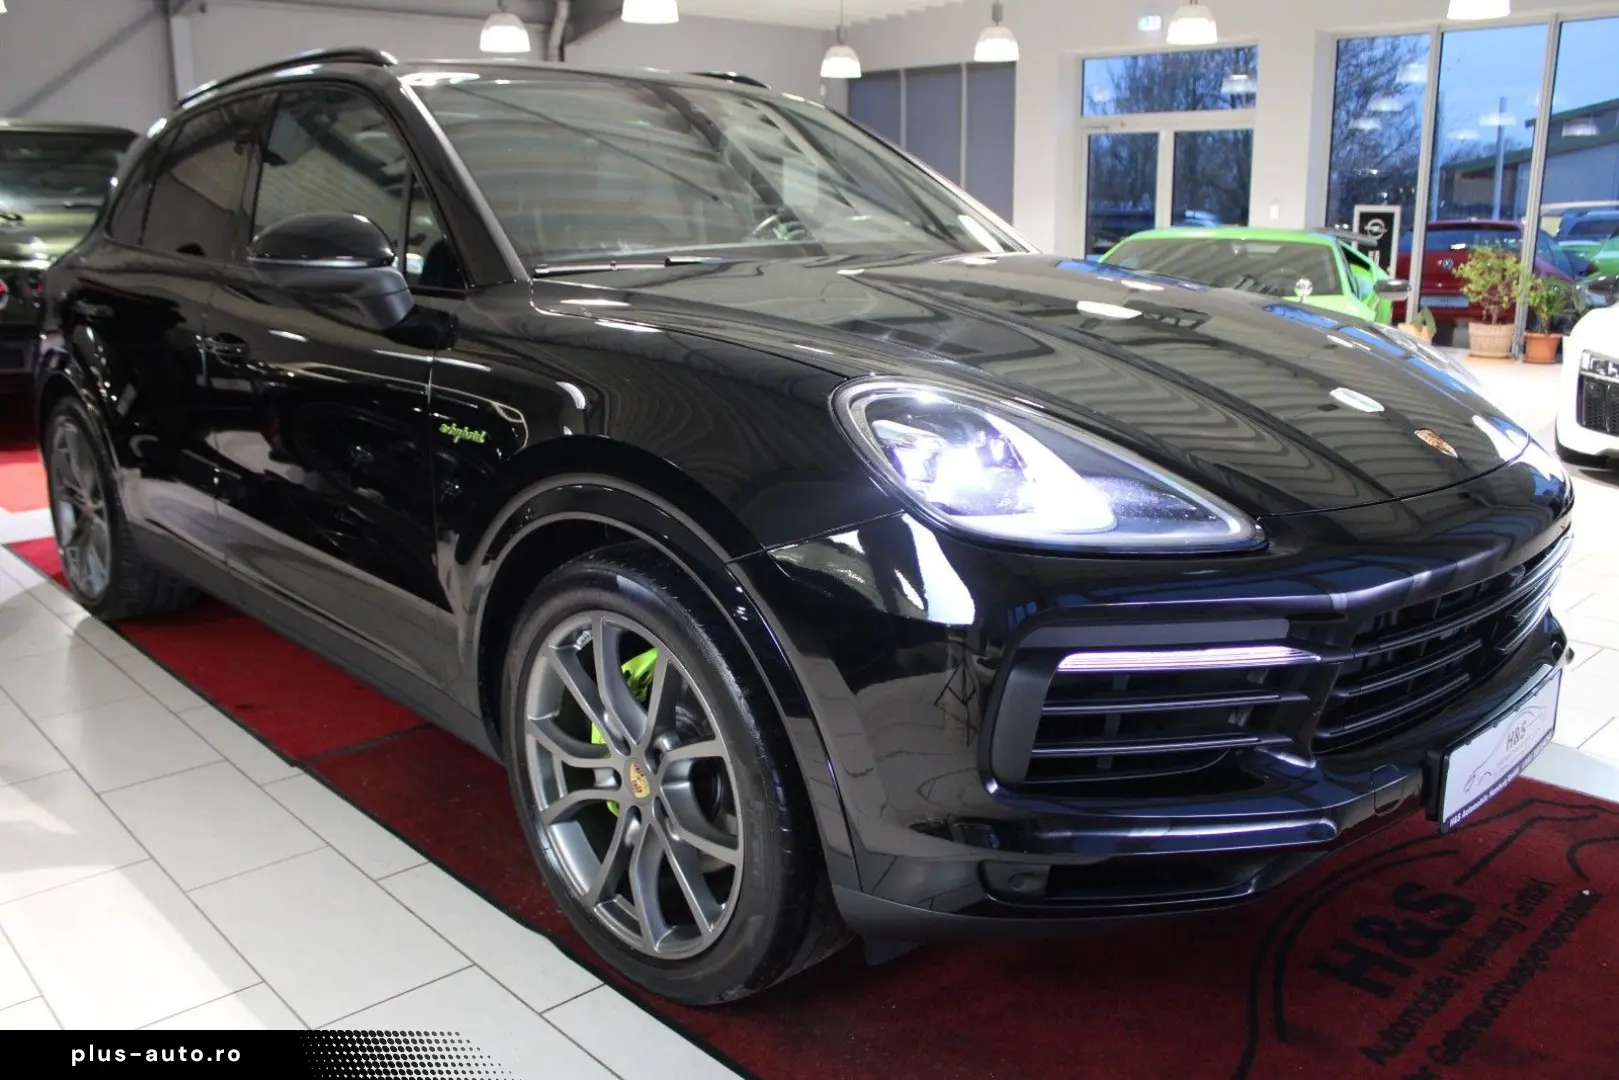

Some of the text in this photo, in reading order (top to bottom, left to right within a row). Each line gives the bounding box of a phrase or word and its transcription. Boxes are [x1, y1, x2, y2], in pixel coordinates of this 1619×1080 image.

[1506, 720, 1530, 752] H&S
[1449, 812, 1462, 828] H&S
[1309, 881, 1476, 999] H&S
[1359, 975, 1464, 1067] Automobile
[1445, 916, 1528, 976] Hamburg
[1500, 877, 1557, 918] GmbH
